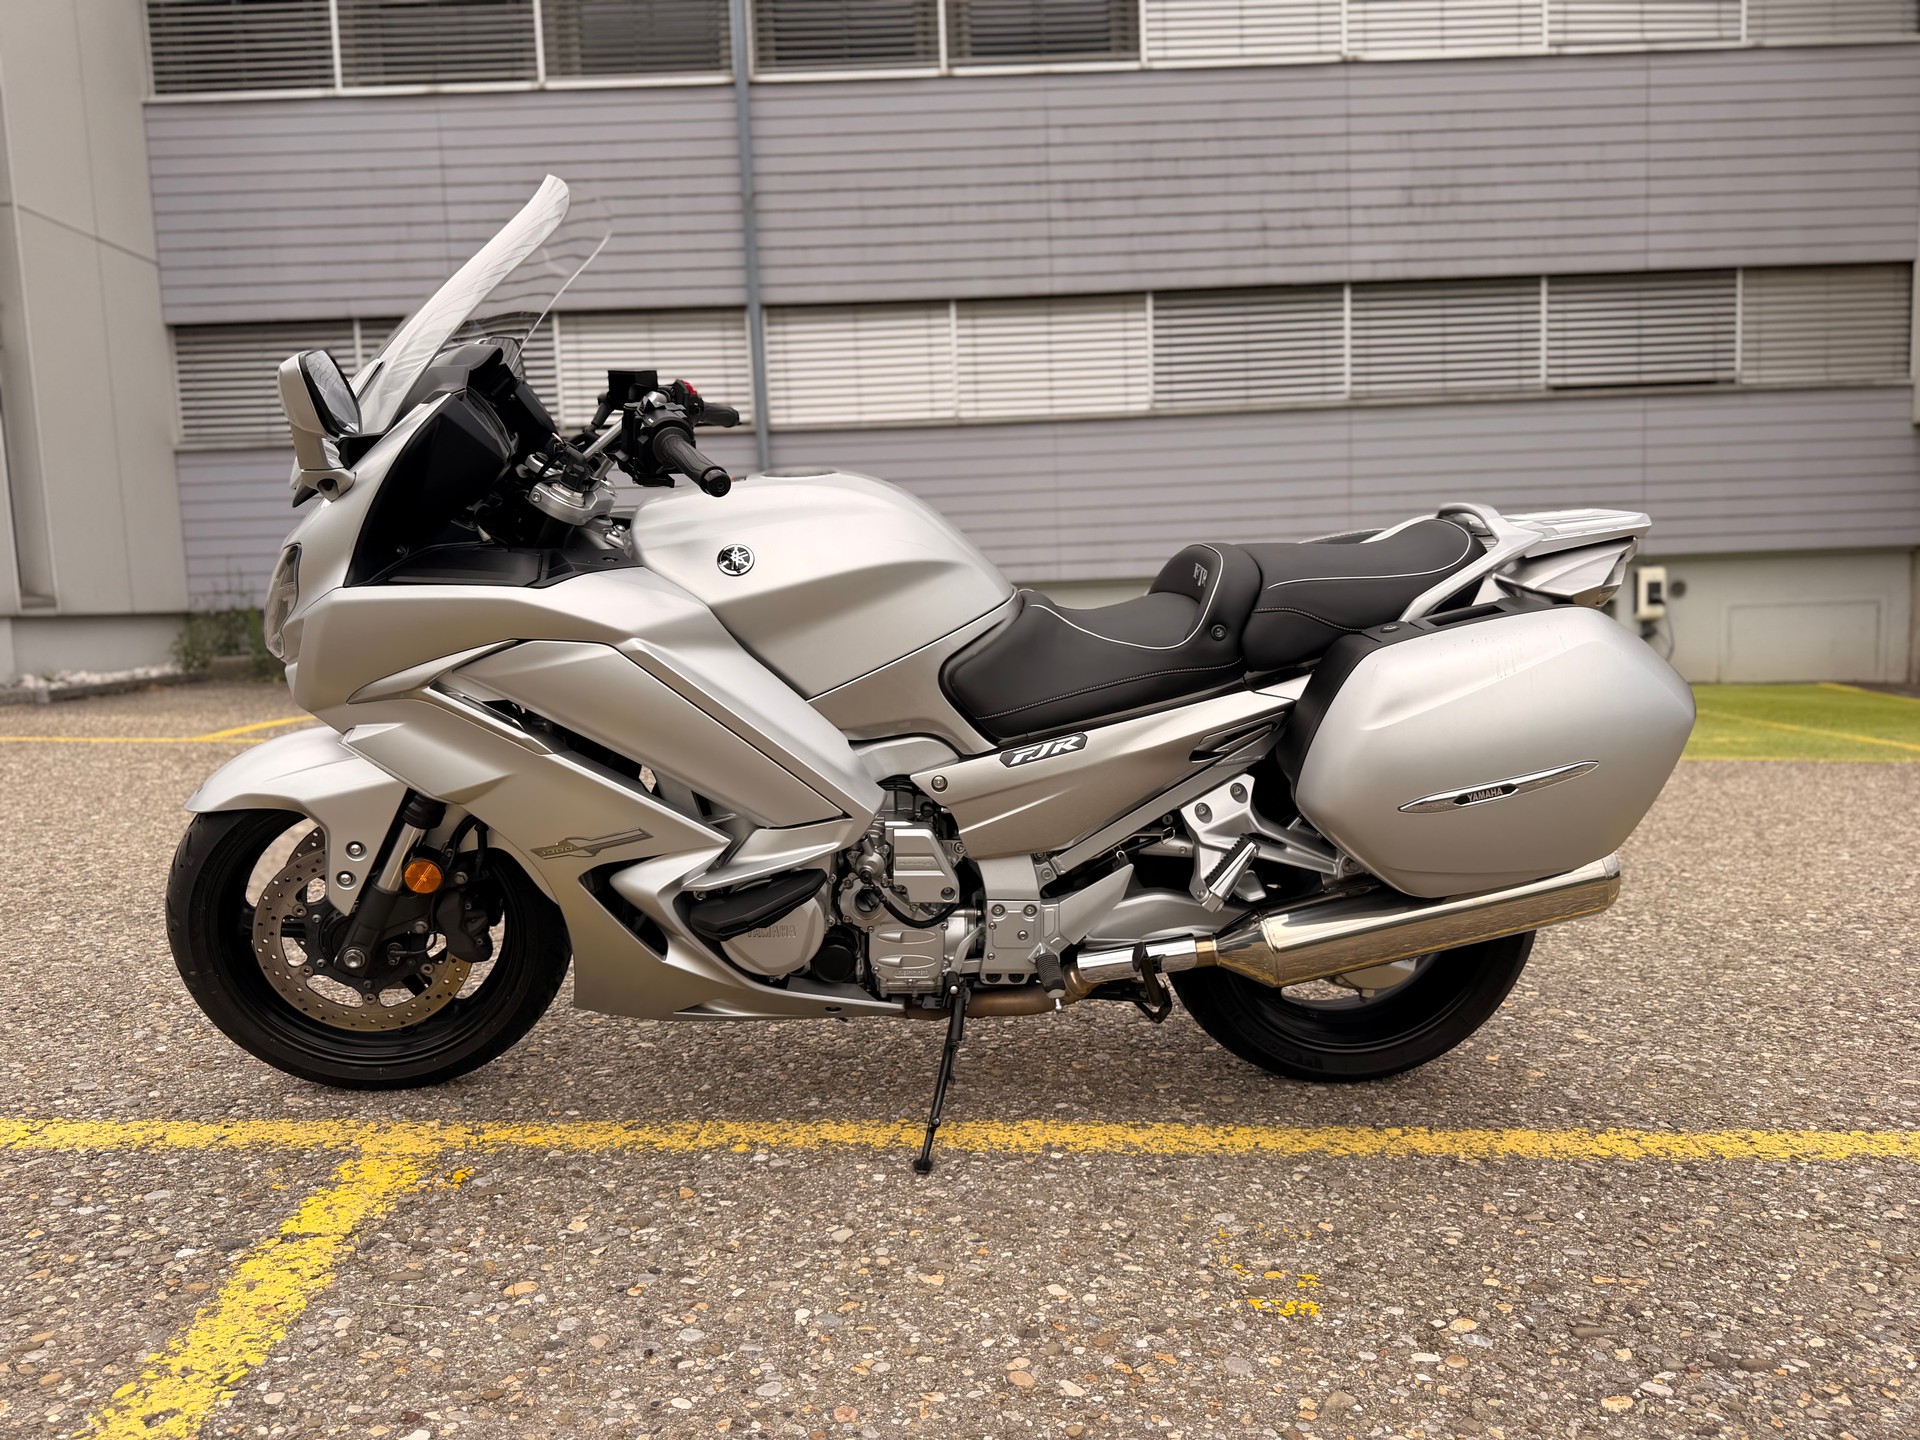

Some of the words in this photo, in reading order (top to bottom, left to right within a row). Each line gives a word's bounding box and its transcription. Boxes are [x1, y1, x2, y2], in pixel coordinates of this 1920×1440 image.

[1009, 736, 1081, 765] FJR
[1467, 787, 1503, 802] YAMAHA
[541, 846, 573, 856] 1300
